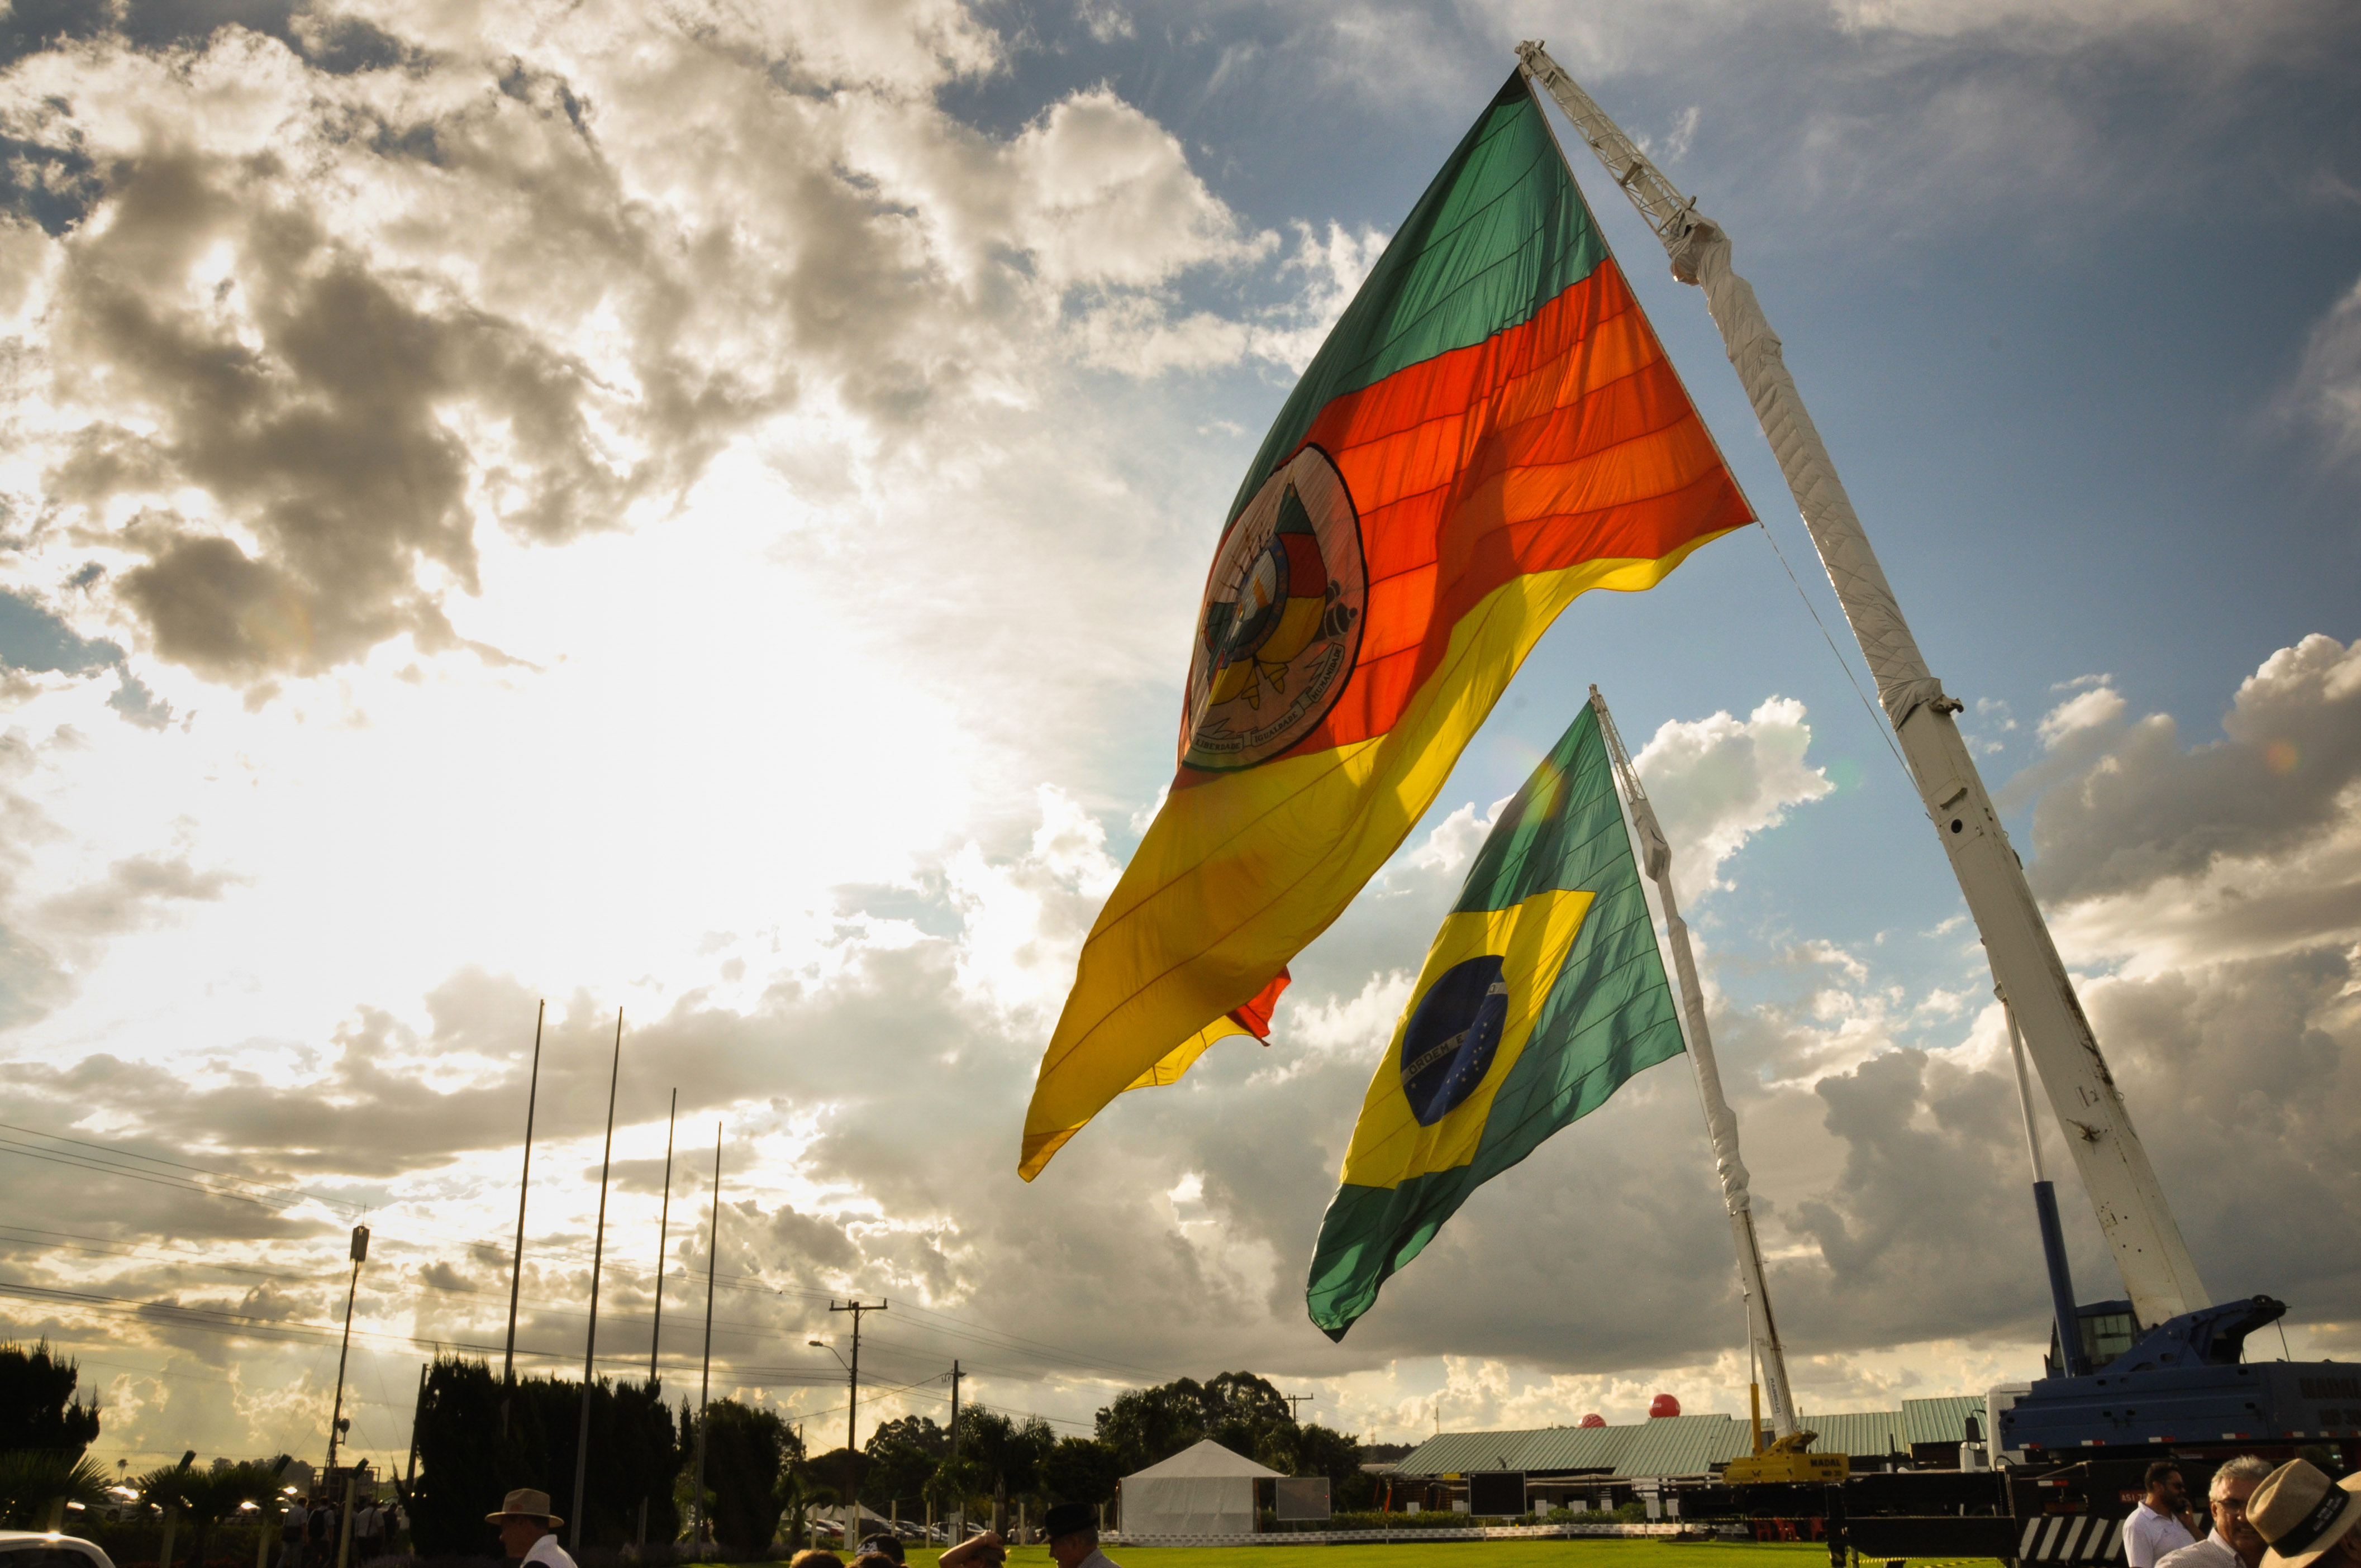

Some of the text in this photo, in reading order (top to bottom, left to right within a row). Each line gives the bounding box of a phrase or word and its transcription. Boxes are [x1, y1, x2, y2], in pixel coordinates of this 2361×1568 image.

[1196, 647, 1342, 751] LIBERDADE IGUALDADE HUMANIDADE
[1408, 1033, 1464, 1075] ORDEM E
